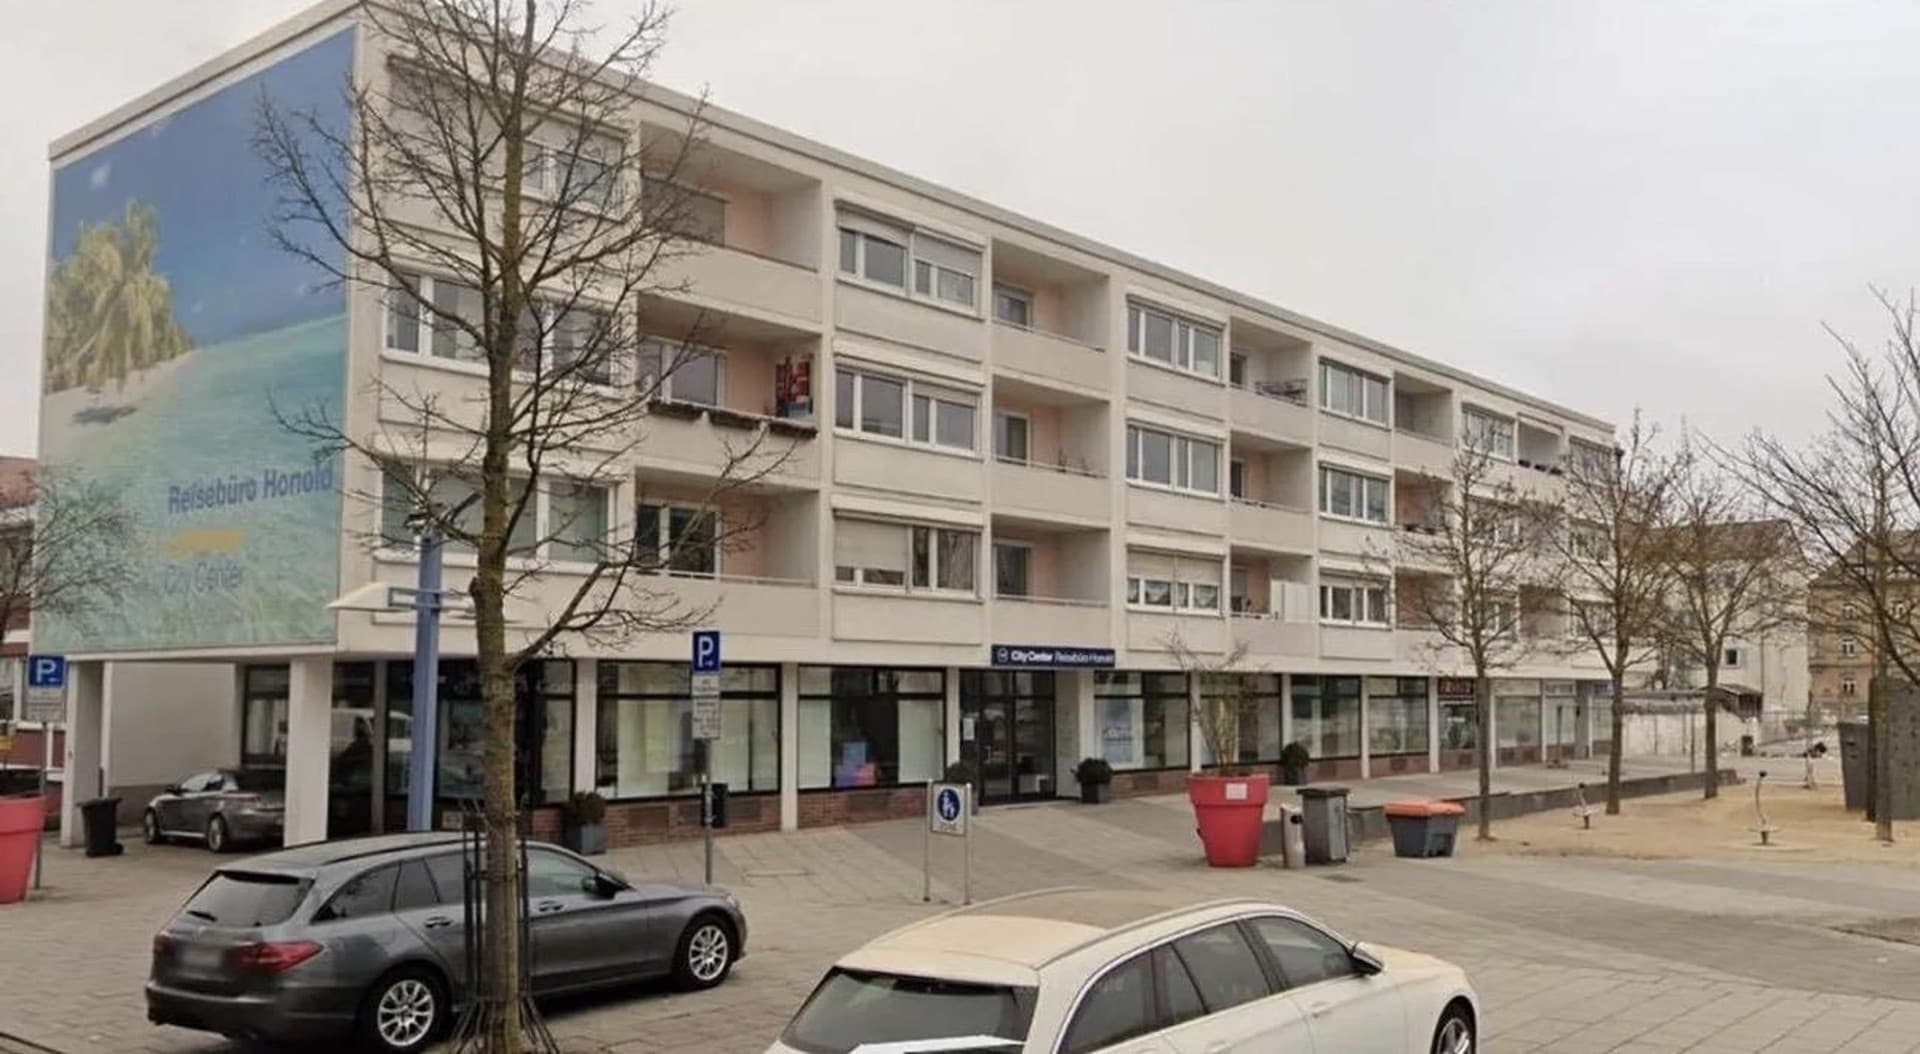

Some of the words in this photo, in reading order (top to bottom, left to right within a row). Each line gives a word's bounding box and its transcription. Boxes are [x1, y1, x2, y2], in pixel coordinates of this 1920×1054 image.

[168, 475, 257, 514] Reisebüro
[263, 462, 333, 499] Honold
[698, 635, 714, 668] P
[1011, 650, 1028, 663] City
[36, 659, 57, 683] P
